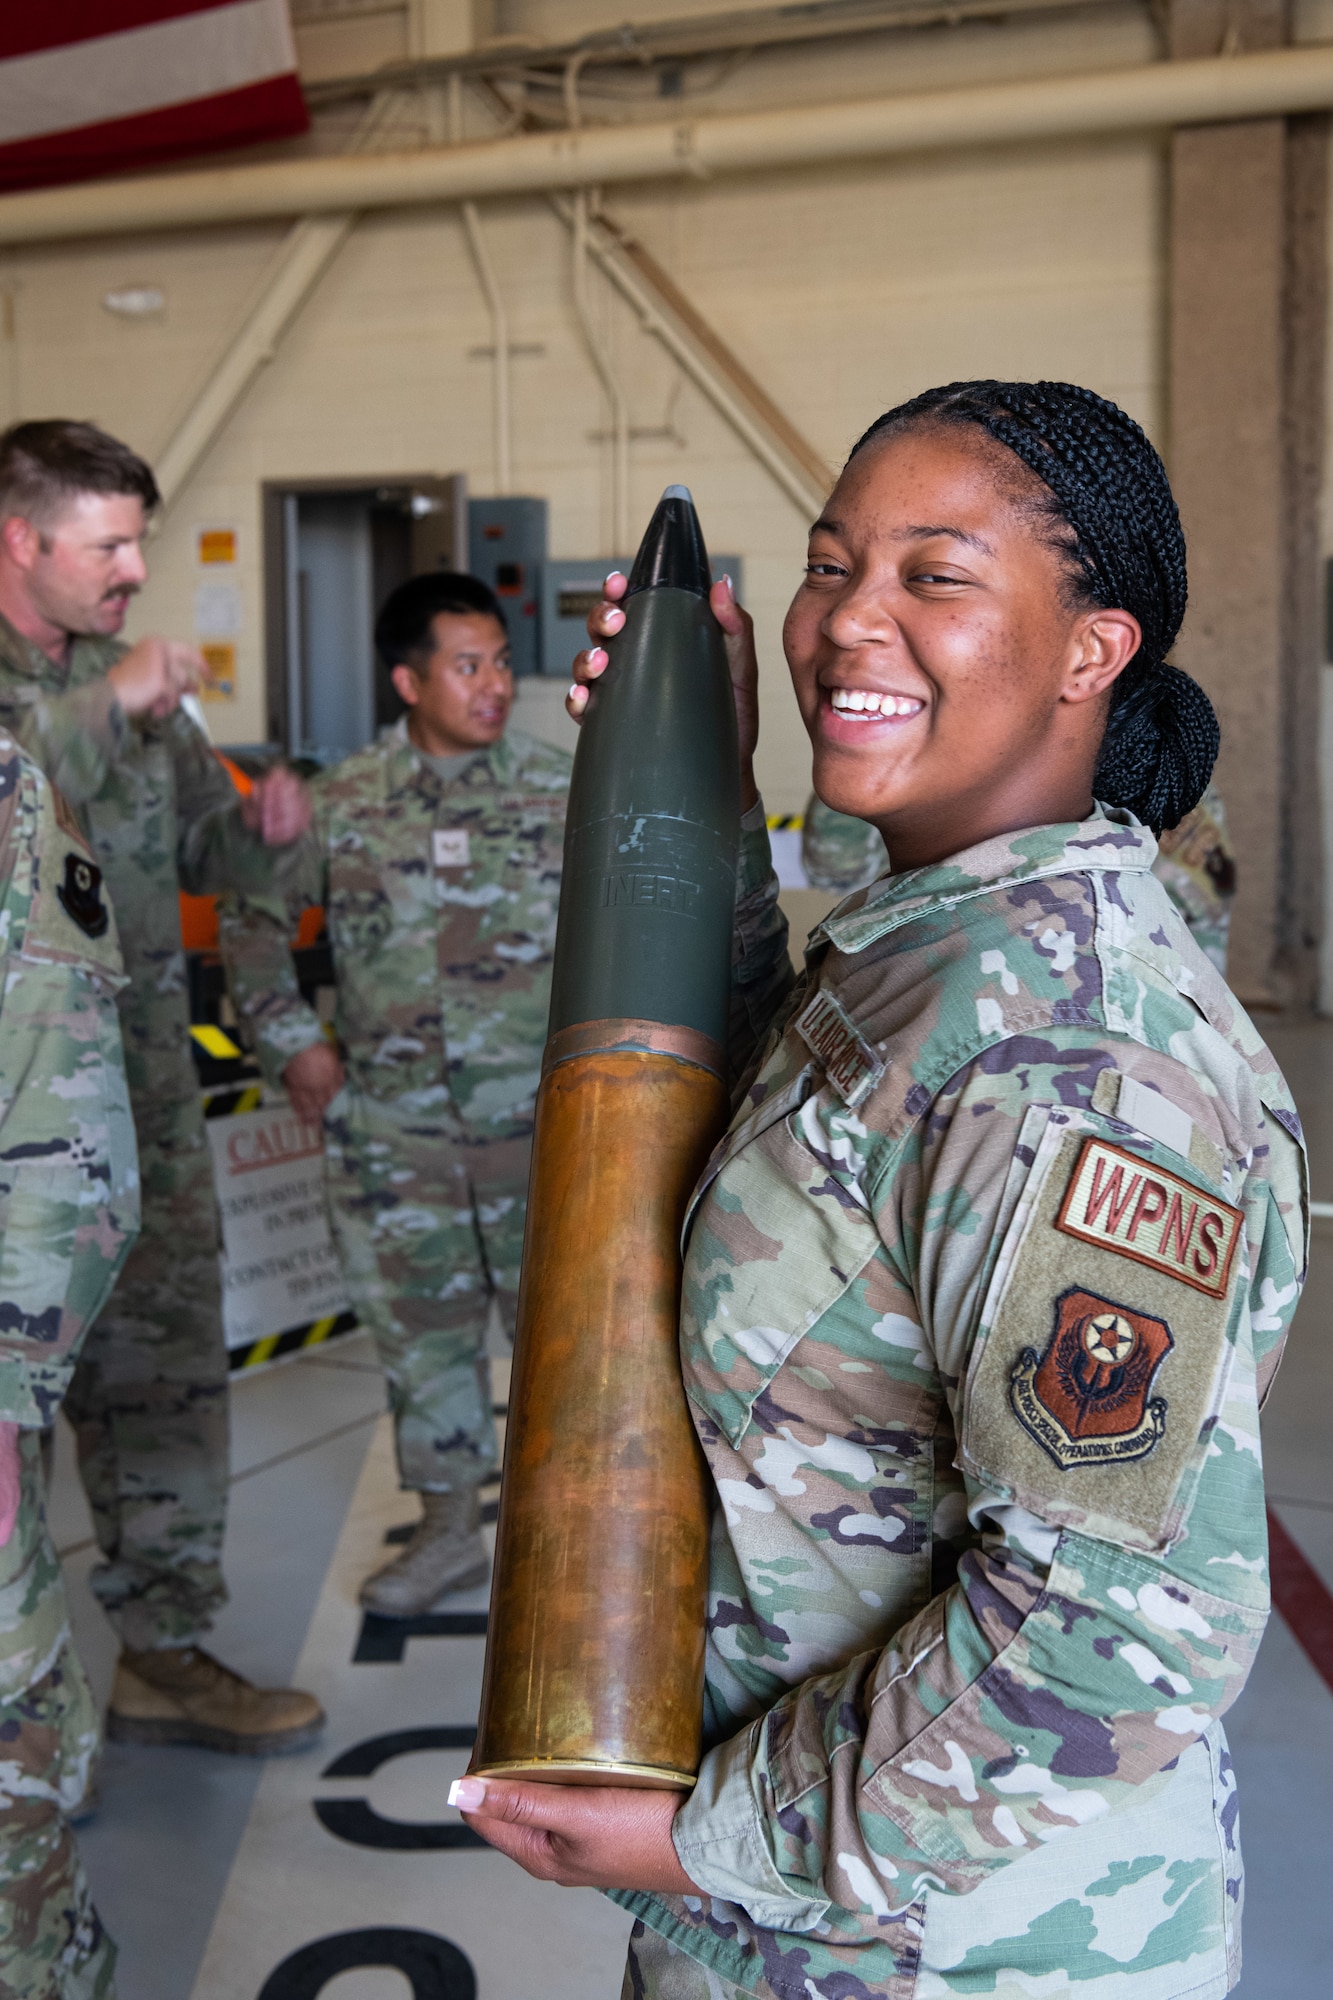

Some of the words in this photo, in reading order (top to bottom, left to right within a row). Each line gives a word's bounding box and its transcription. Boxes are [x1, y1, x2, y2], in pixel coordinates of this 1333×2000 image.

[601, 874, 700, 913] INERT
[814, 1018, 849, 1059] AIR
[829, 1036, 872, 1093] ORCE
[227, 1117, 322, 1164] CAUT
[1083, 1157, 1223, 1278] WPNS
